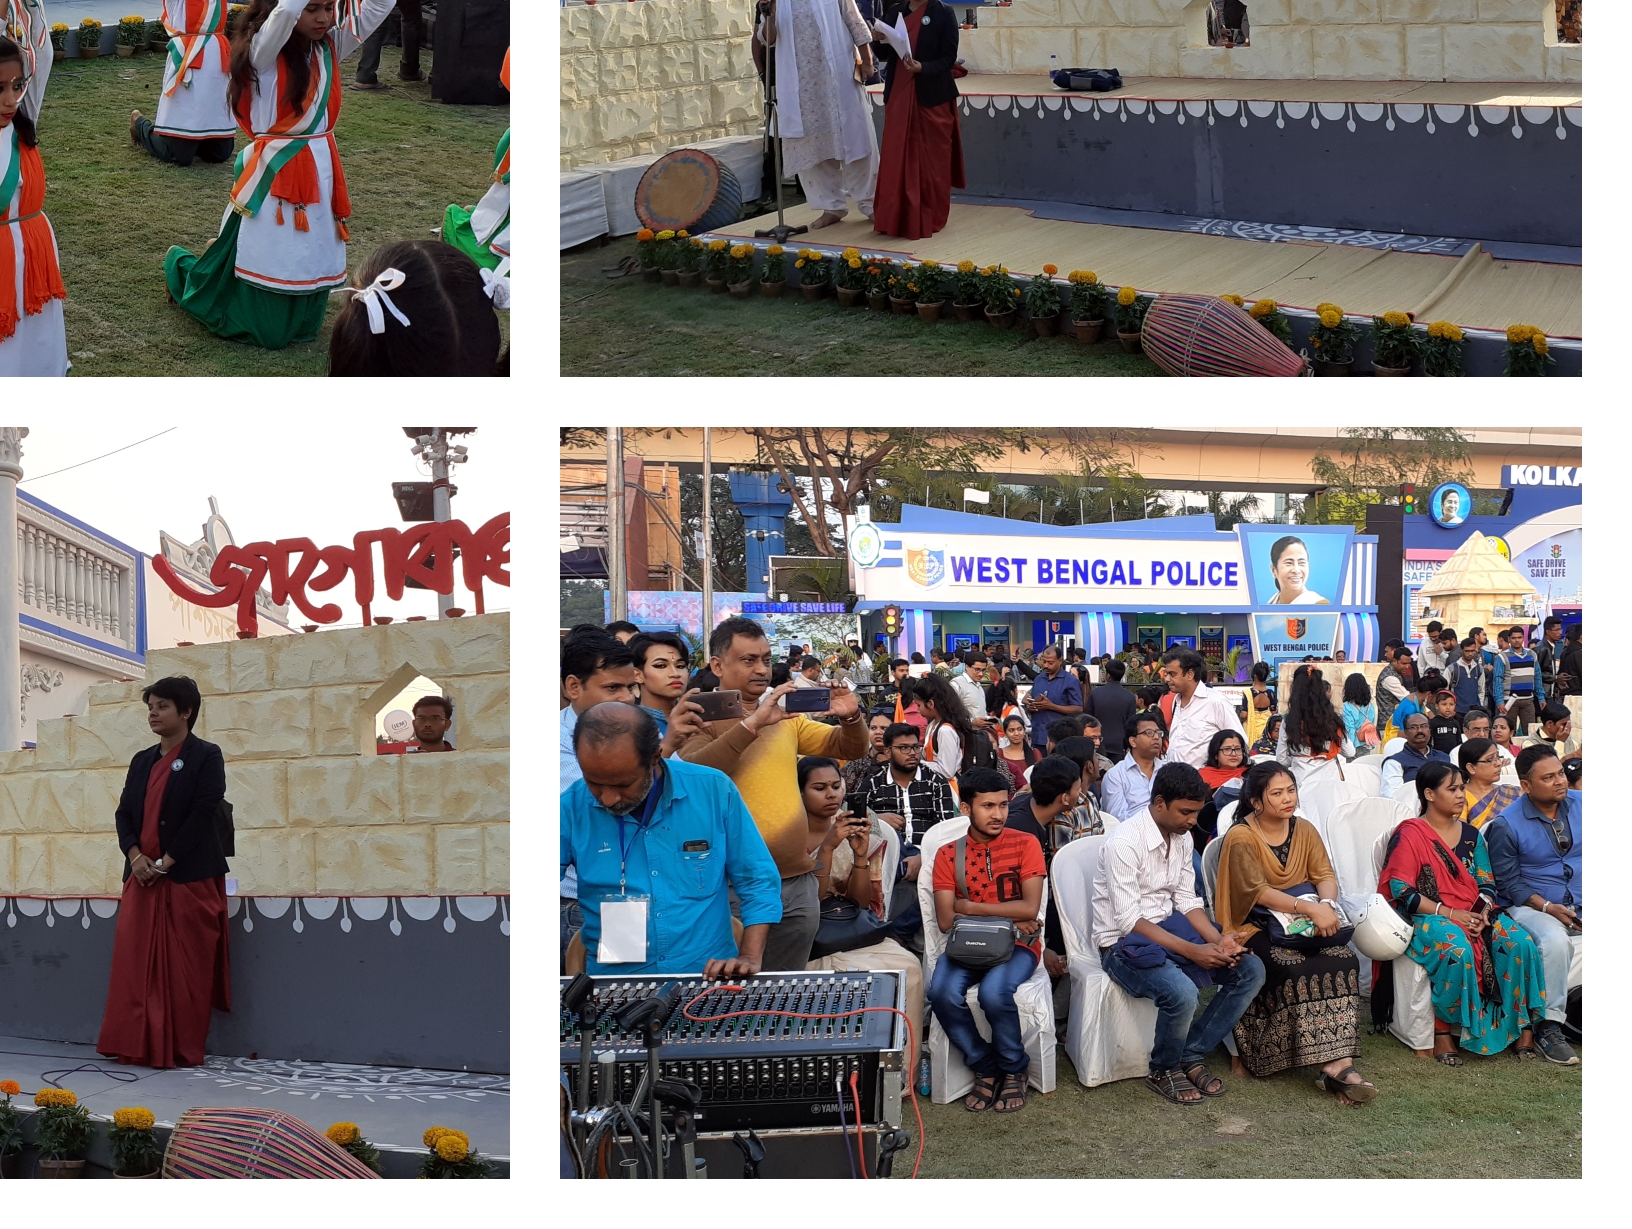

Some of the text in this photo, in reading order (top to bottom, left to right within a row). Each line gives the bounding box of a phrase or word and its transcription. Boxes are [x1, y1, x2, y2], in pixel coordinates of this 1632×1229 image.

[1527, 558, 1566, 568] SAFE DRIVE
[951, 555, 1027, 584] WEST
[1037, 558, 1142, 586] BENGAL
[1151, 560, 1238, 586] POLICE
[1530, 568, 1566, 578] SAVE LIFE
[743, 602, 846, 613] SAFE DRIVE SAVE LIFE
[1308, 643, 1329, 651] POLICE
